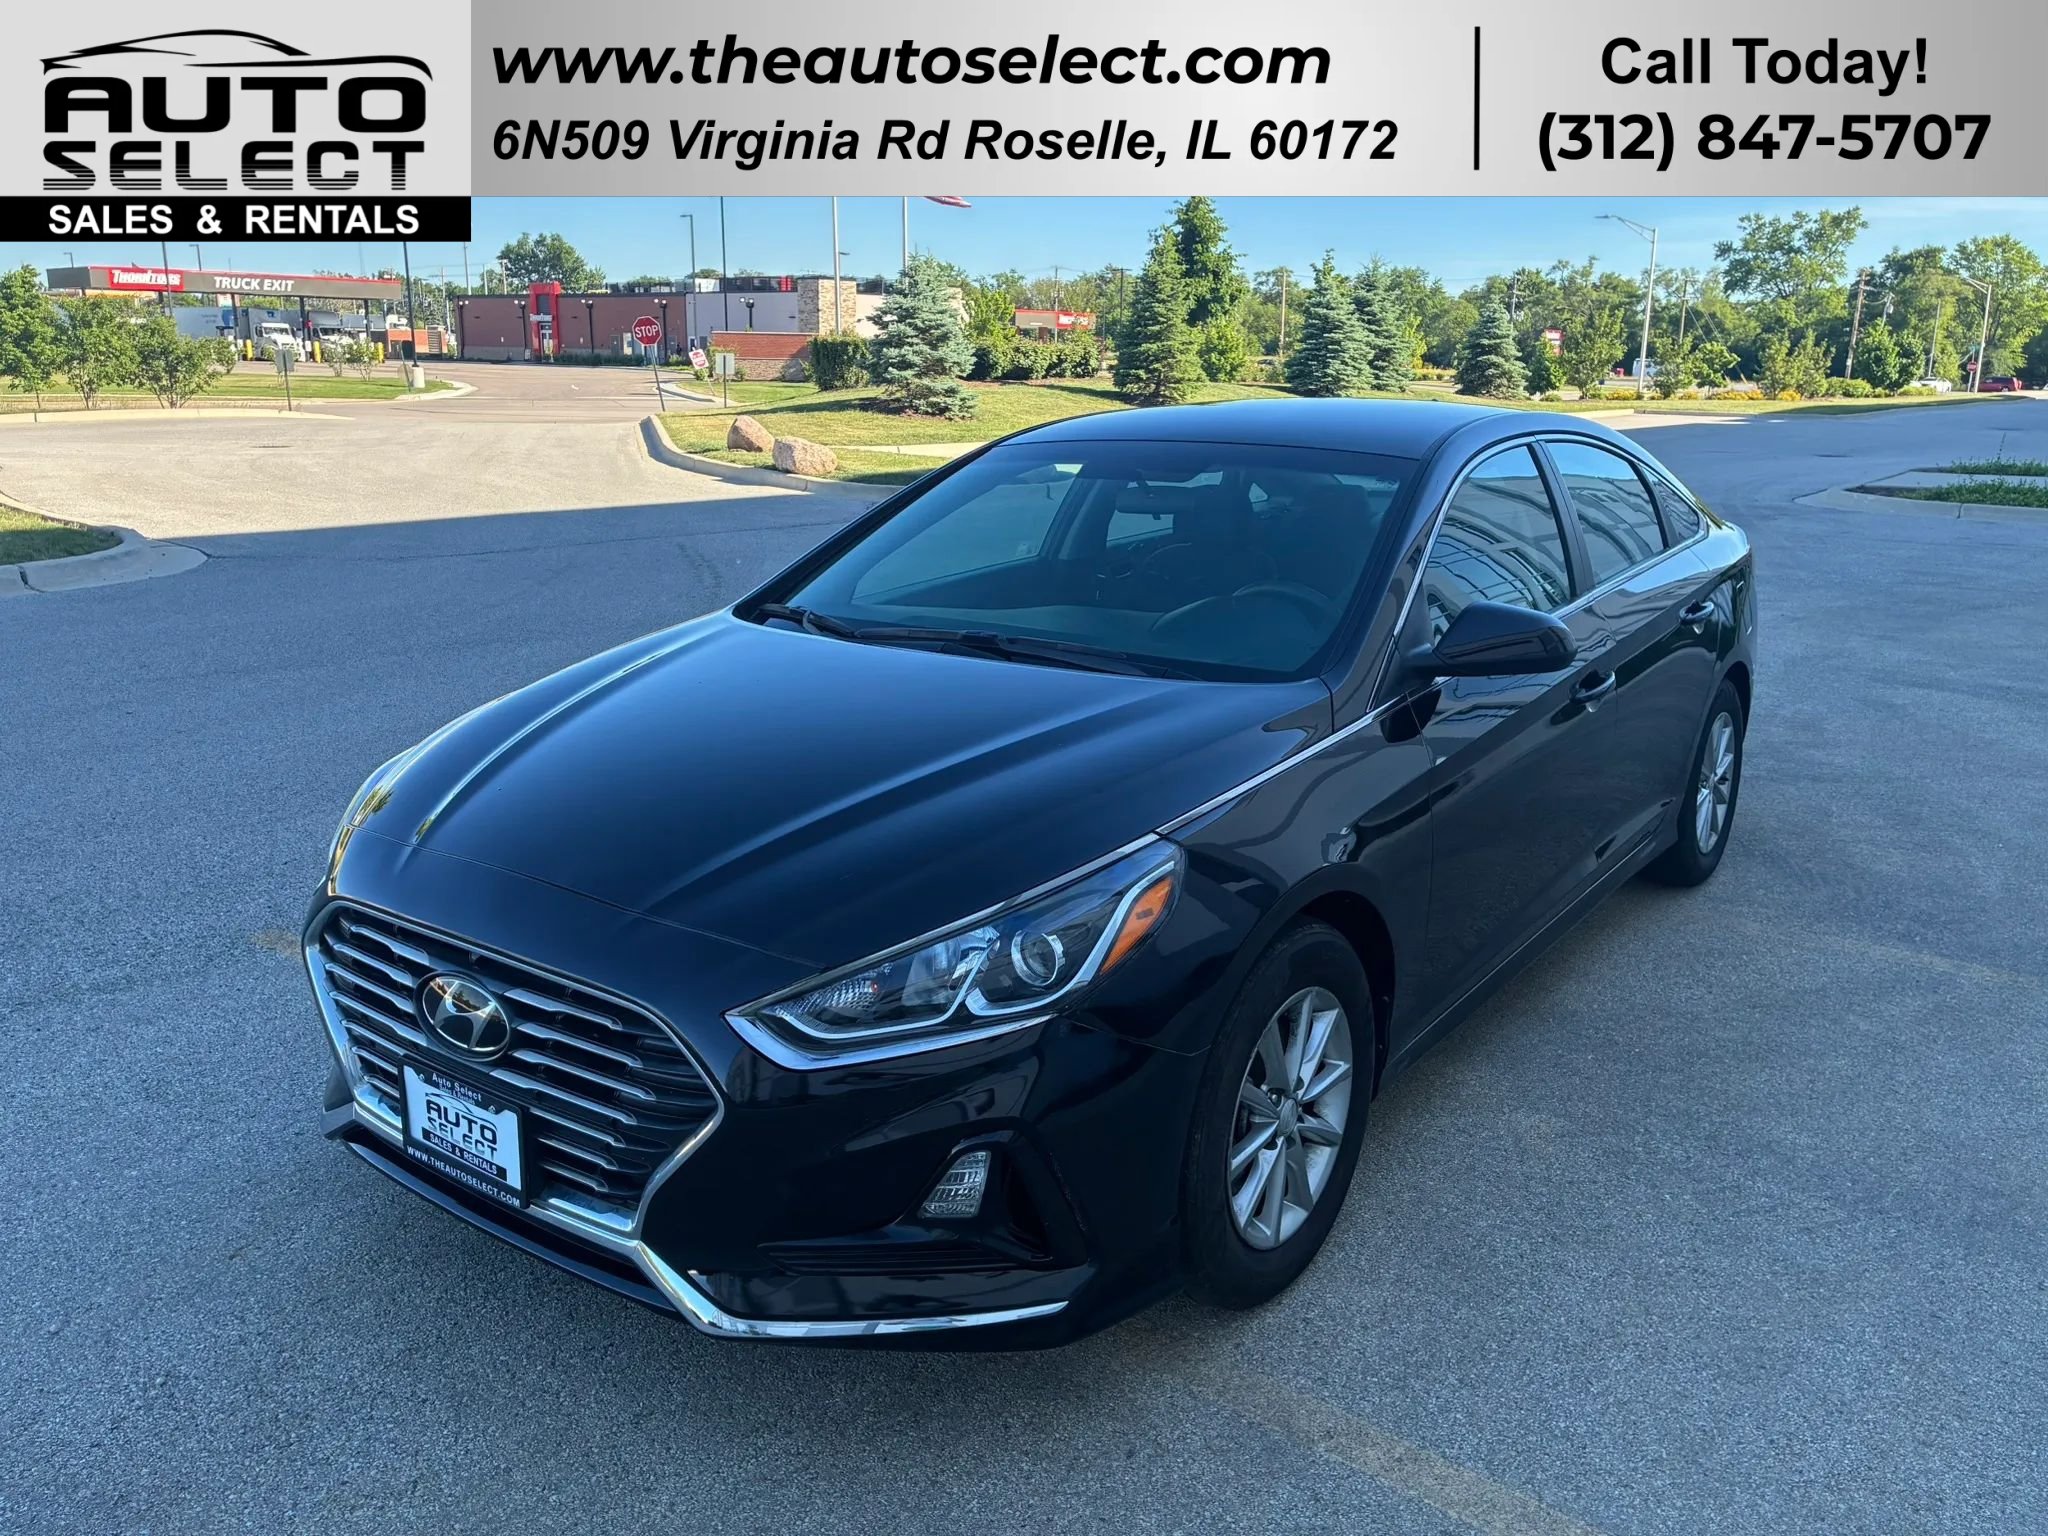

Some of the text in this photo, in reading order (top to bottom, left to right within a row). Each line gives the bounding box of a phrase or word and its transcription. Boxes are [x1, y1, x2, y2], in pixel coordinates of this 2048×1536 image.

[214, 276, 295, 292] TRUCK EXIT
[635, 324, 659, 338] STOP
[432, 1072, 482, 1102] Auto Select
[426, 1099, 497, 1145] AUTO
[427, 1116, 497, 1161] SELECT
[430, 1133, 497, 1174] SALES & RENTALS
[407, 1145, 520, 1207] WWW.THEAUTOSELECT.COM
